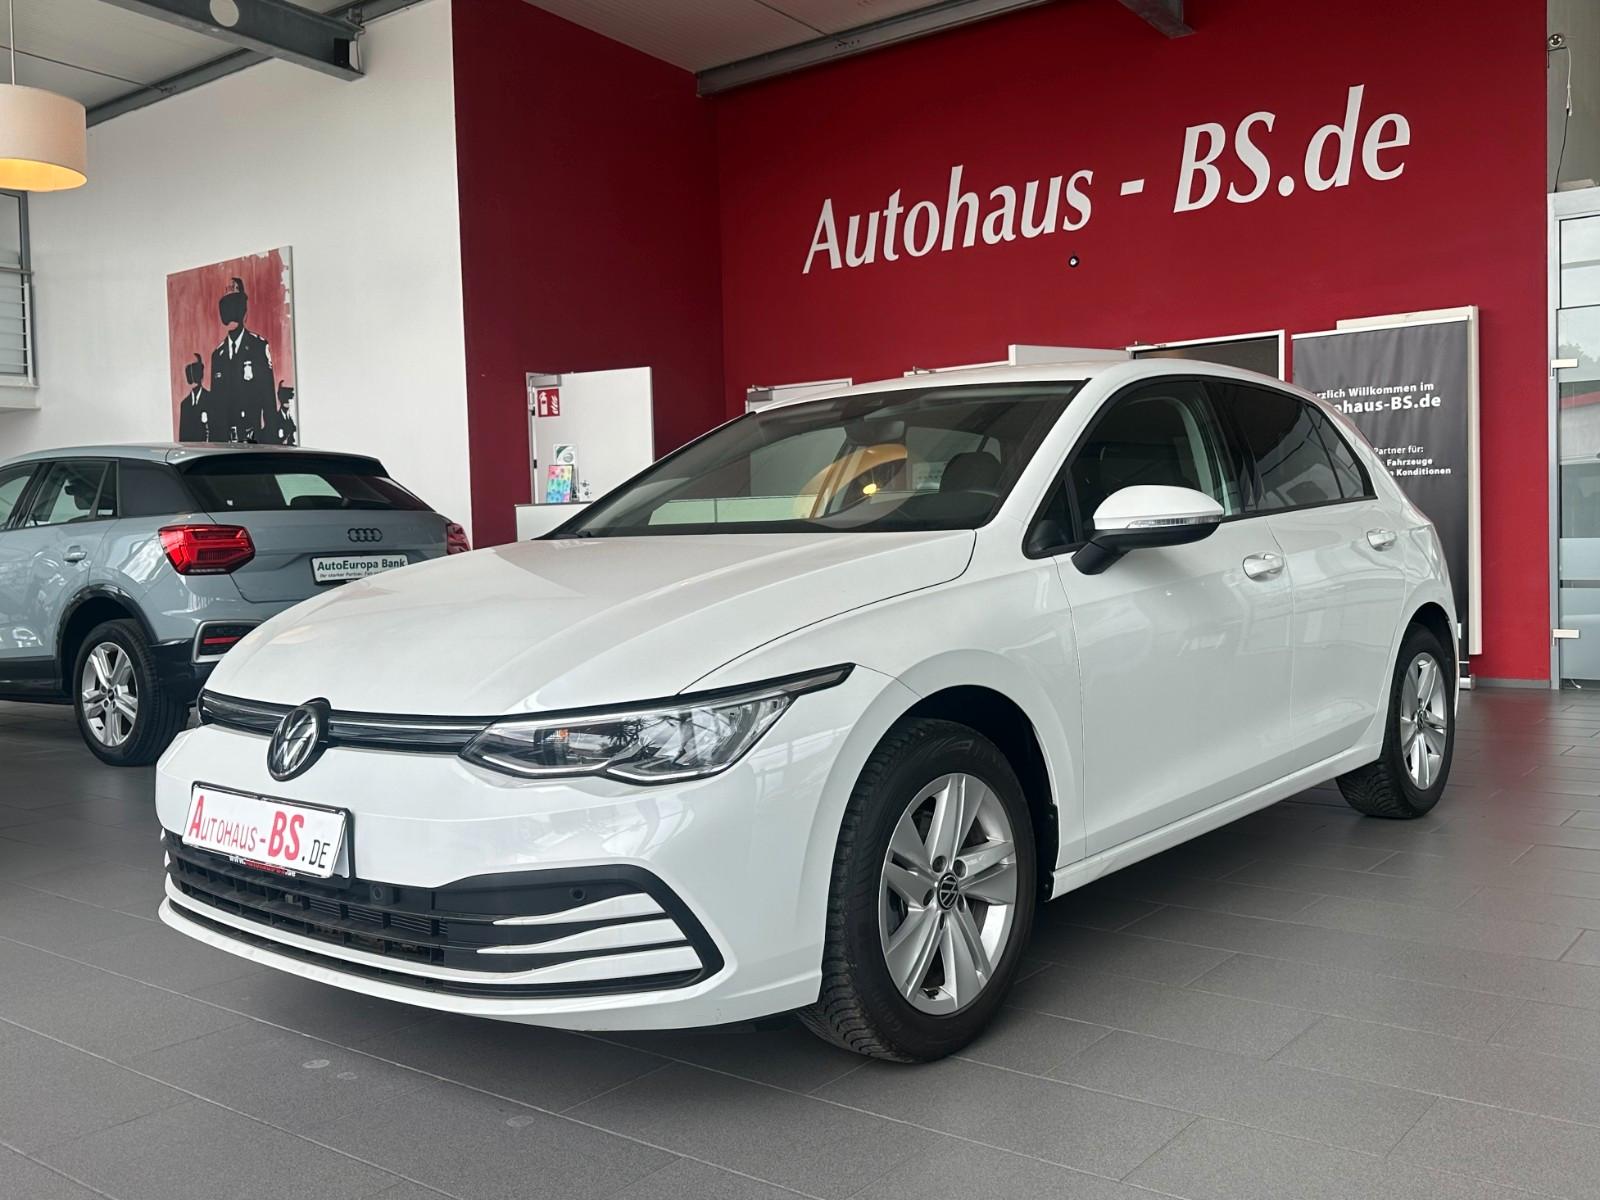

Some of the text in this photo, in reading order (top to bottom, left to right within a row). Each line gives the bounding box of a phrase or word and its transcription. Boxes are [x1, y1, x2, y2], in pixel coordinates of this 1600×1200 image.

[802, 164, 1094, 274] Autohaus
[1173, 84, 1411, 214] BS.de
[1316, 381, 1435, 400] rzlich Willkommen im
[1334, 393, 1442, 414] ohaus-BS.de
[1408, 444, 1424, 454] für:
[1386, 458, 1433, 467] Fahrzeuge
[1396, 467, 1452, 477] Konditionen
[317, 558, 405, 572] AutoEuropa Bank
